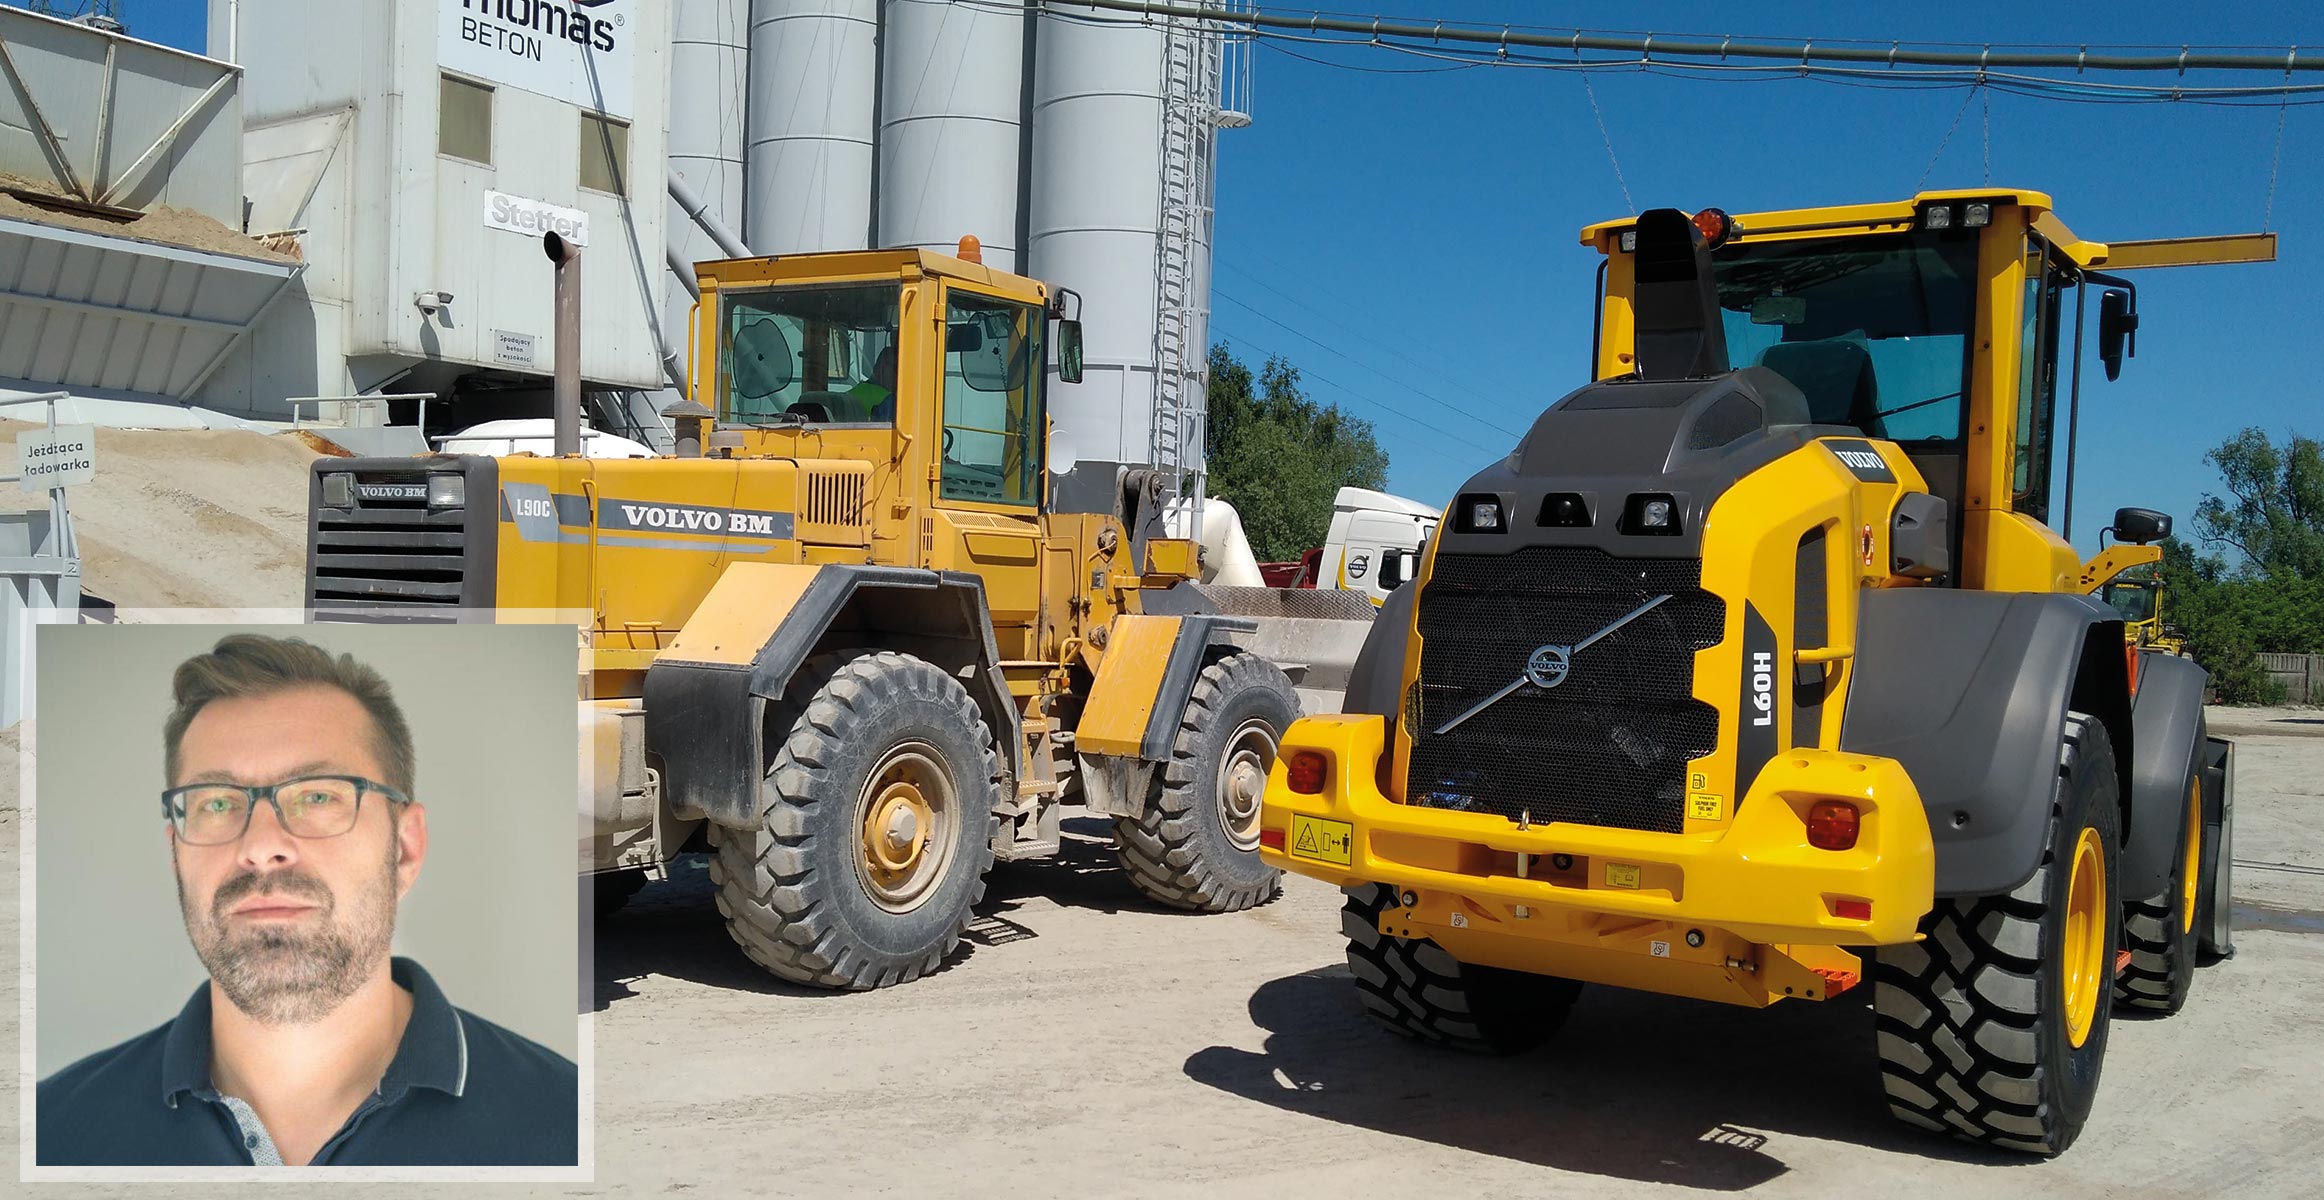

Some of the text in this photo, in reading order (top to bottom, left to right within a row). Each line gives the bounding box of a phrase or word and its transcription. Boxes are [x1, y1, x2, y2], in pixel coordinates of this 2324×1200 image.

[463, 0, 615, 52] omas
[462, 16, 541, 62] BETON
[492, 195, 582, 239] Stetter
[27, 442, 83, 458] Jeżdżąca
[1834, 450, 1885, 469] VOLVO
[24, 458, 90, 476] ładowarka
[360, 487, 427, 497] VOLVO BM
[517, 499, 551, 518] L90C
[621, 505, 773, 534] VOLVO BM
[1530, 661, 1568, 671] VOLVO
[1753, 652, 1772, 727] L60H
